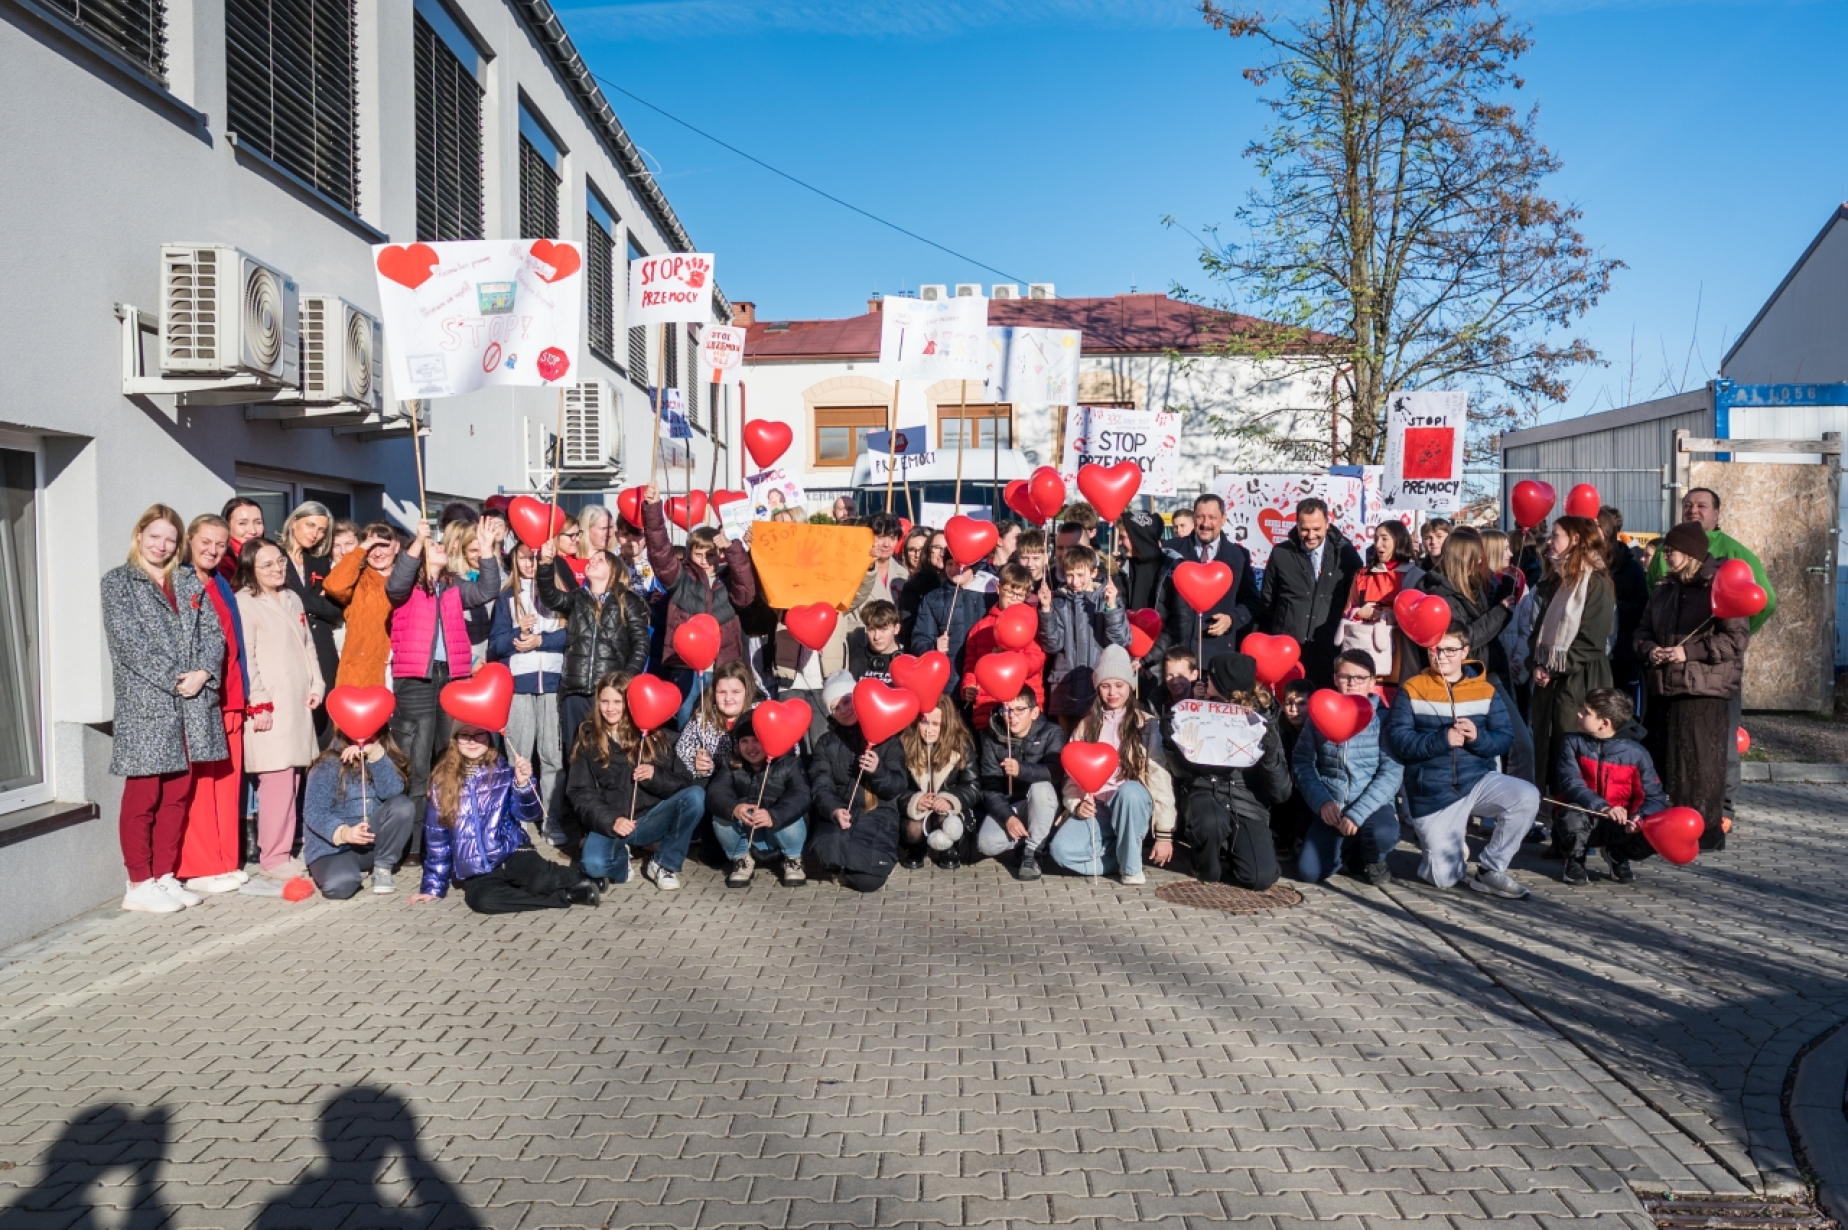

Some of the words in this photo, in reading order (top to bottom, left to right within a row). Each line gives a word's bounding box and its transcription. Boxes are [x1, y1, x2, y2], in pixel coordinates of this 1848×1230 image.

[641, 257, 683, 285] STOP
[642, 290, 698, 308] PRZEMOCY
[1098, 430, 1147, 452] STOP
[1402, 480, 1460, 495] PREMOCY
[759, 524, 798, 546] STOP
[1178, 702, 1203, 713] STOP
